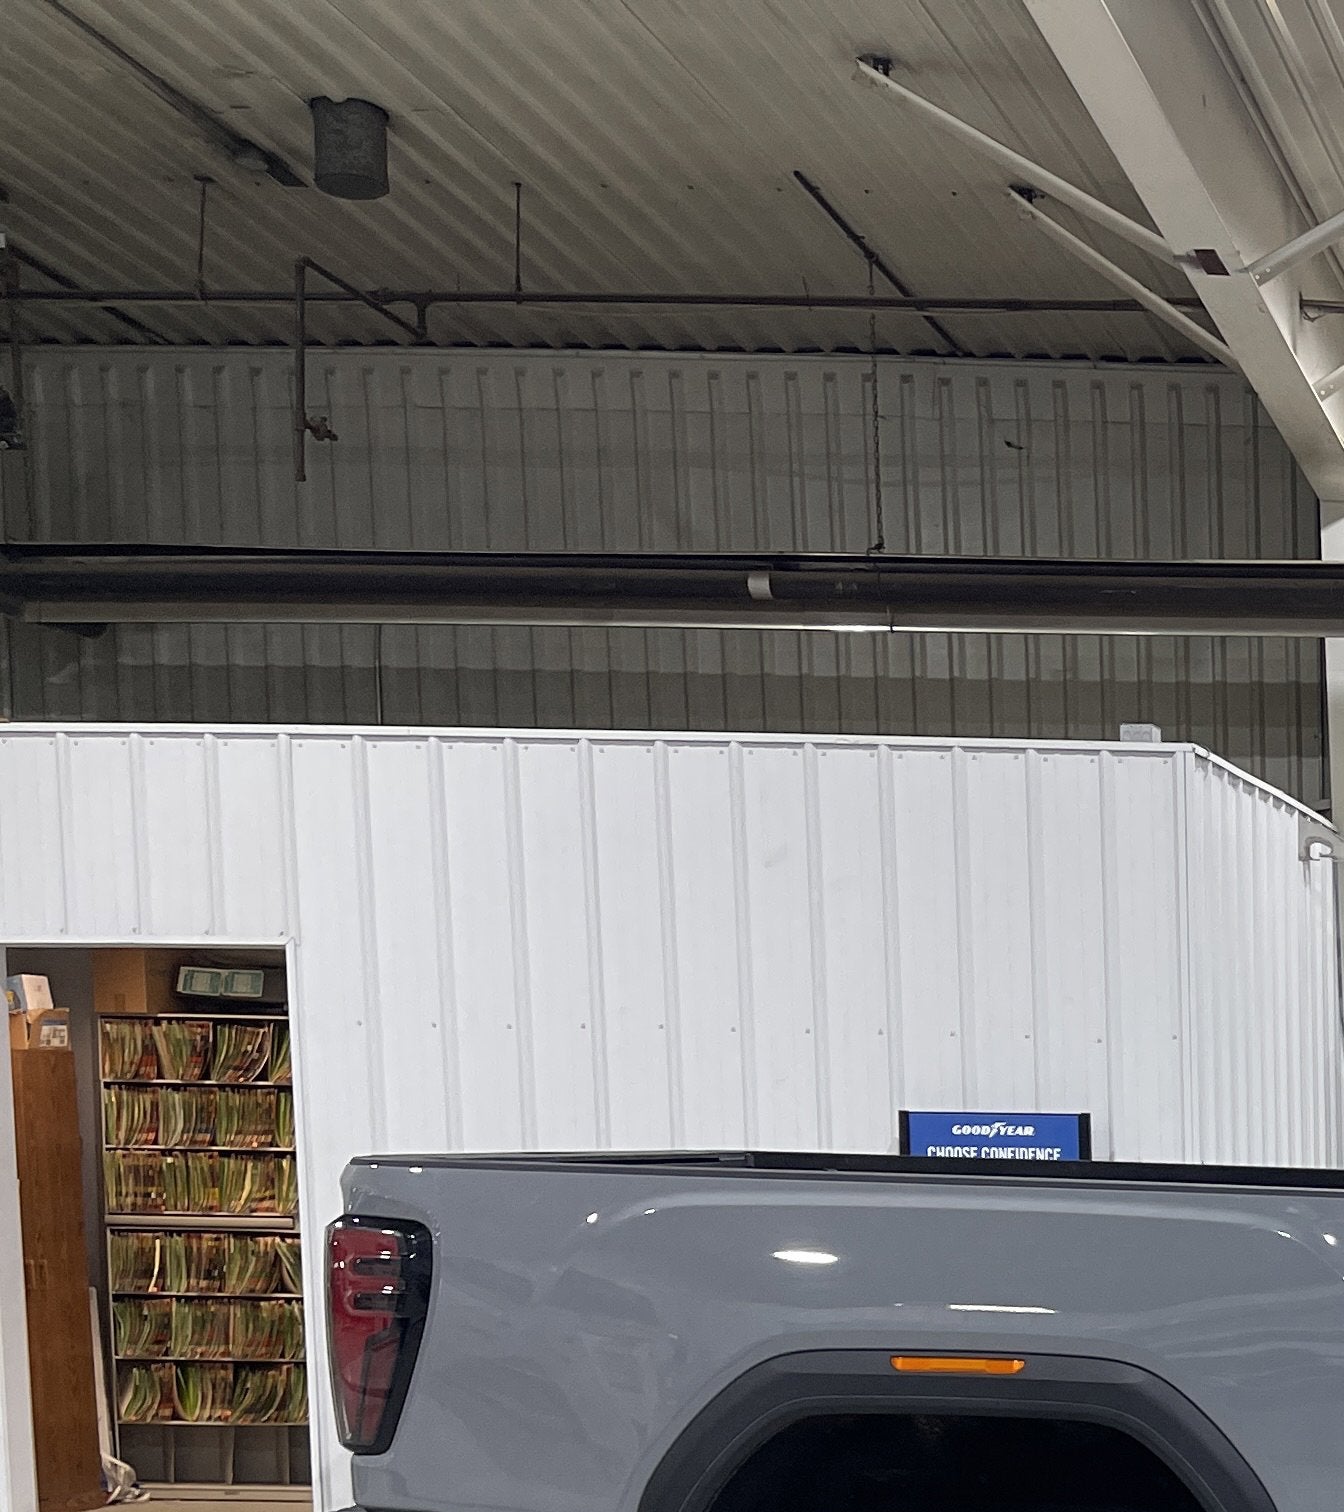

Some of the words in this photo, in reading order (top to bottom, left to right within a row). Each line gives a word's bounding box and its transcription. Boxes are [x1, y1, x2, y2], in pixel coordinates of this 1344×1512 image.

[952, 1121, 1035, 1138] GOODYEAR
[927, 1145, 978, 1158] CHOOSE
[981, 1147, 1061, 1161] CONFIDENCE
